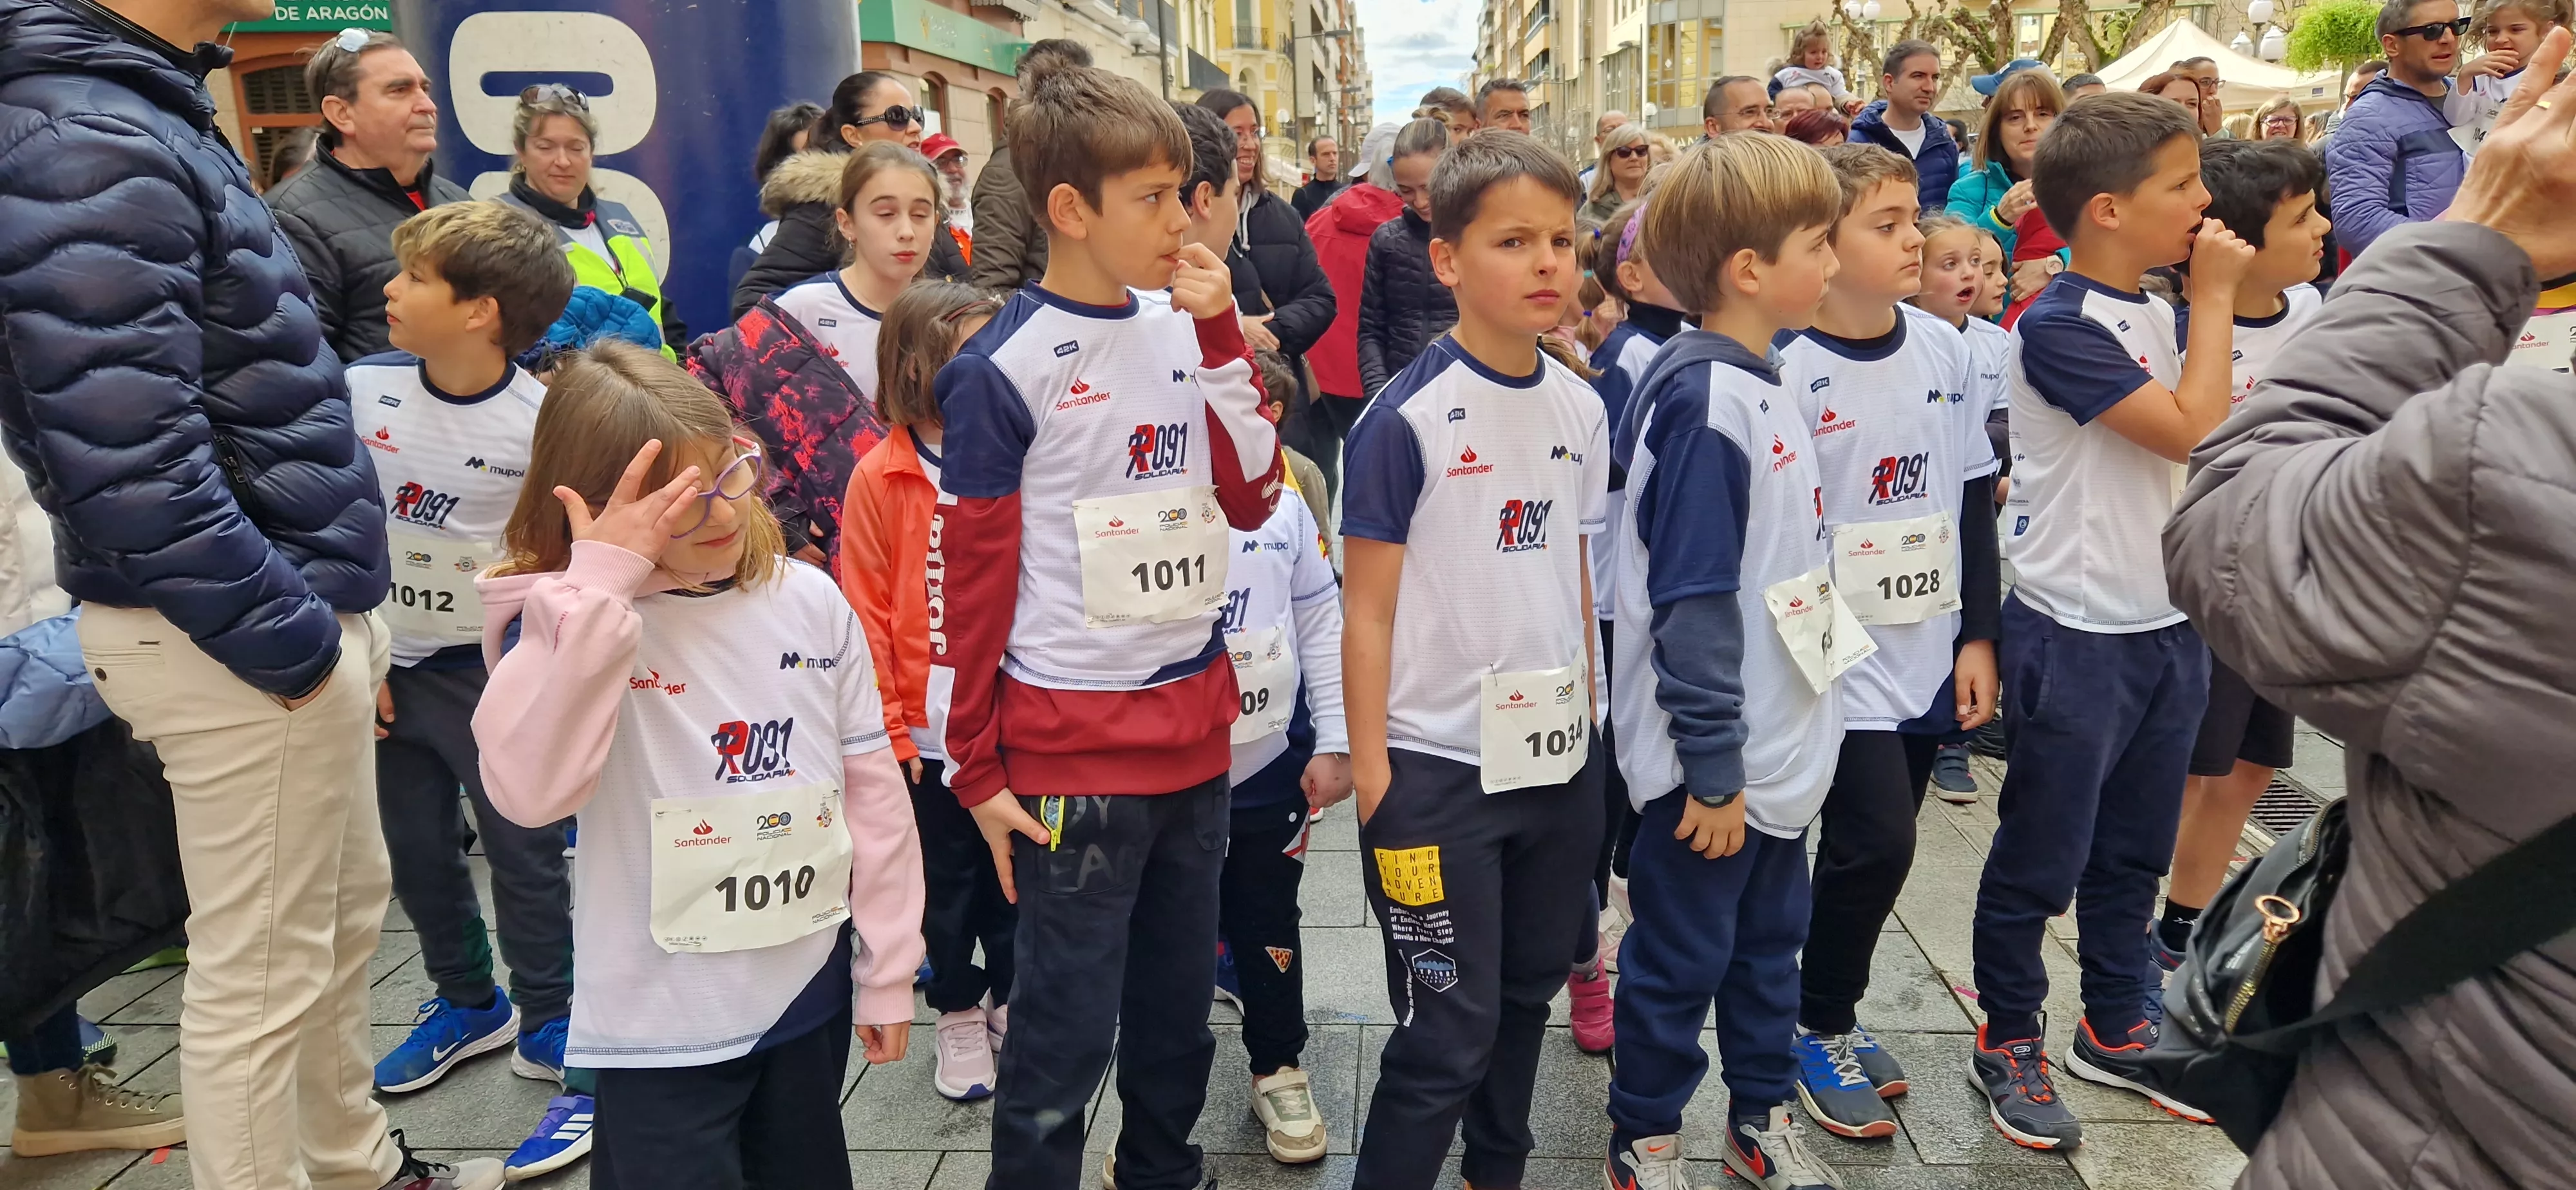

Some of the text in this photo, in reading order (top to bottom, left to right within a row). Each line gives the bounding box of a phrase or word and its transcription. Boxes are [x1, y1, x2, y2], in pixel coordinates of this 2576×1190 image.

[275, 4, 389, 21] DE ARAGÓN
[1056, 342, 1077, 355] 42K
[2512, 341, 2550, 350] antander
[1980, 372, 2000, 382] mupo
[1056, 391, 1112, 411] Santander
[1813, 419, 1856, 437] antander
[361, 435, 400, 455] Santander
[1135, 468, 1184, 480] SOLIDARIA
[1446, 464, 1494, 478] Santander
[1875, 492, 1926, 506] SOLIDARIA
[1095, 527, 1140, 538] Santander
[1264, 542, 1289, 552] mupo
[1848, 549, 1886, 557] Santander
[1131, 554, 1205, 593] 1011
[1877, 568, 1940, 601] 1028
[390, 581, 455, 612] 1012
[806, 657, 837, 672] mupo
[1240, 687, 1269, 715] 09
[1495, 701, 1539, 710] Santander
[1524, 715, 1583, 757] 1034
[726, 769, 791, 784] SOLIDARIA
[674, 835, 732, 848] Santander
[715, 865, 815, 912] 1010
[1426, 910, 1449, 921] Journey
[1437, 927, 1454, 936] Step
